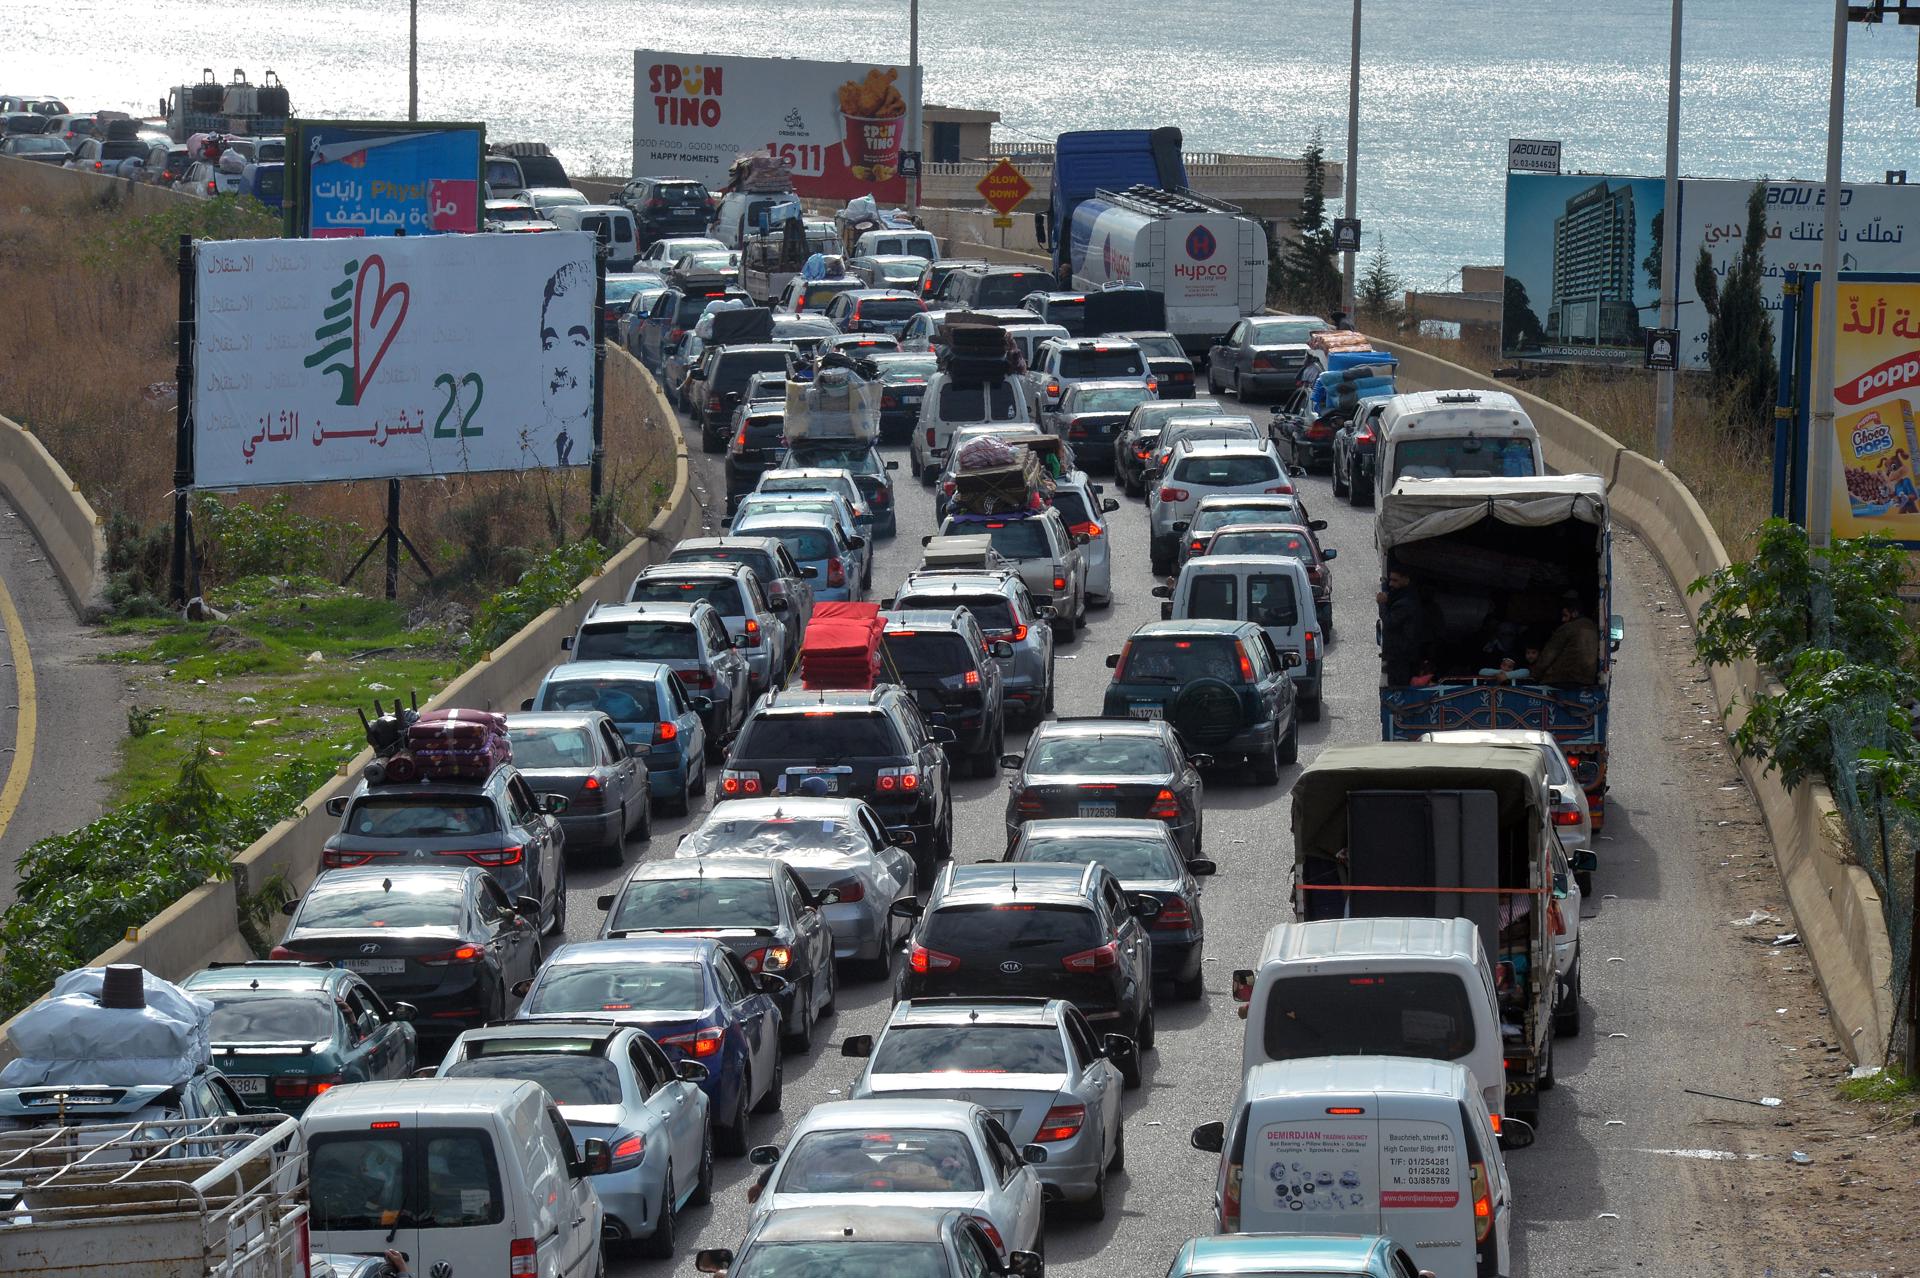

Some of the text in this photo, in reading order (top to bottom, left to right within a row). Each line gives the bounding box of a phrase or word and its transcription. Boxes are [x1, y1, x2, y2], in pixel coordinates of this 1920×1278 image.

[655, 96, 721, 128] TINO
[659, 140, 682, 149] FOOD
[688, 142, 713, 151] GOOD
[866, 137, 894, 150] TINO
[1512, 143, 1541, 156] ABOU
[650, 152, 719, 164] HAPPY MOMENTS
[990, 175, 1019, 184] SLOW
[989, 190, 1019, 198] DOWN
[1762, 187, 1853, 206] BOU ED
[207, 255, 254, 273] الاستقلال
[1174, 263, 1228, 281] Hypco
[433, 372, 484, 439] 22
[242, 409, 299, 465] الثاني
[1852, 426, 1888, 446] Choco
[1855, 435, 1893, 457] POPS
[1003, 963, 1019, 971] KIA
[1267, 1131, 1321, 1140] DEMIRDJIAN
[1383, 1145, 1398, 1154] High
[1390, 1158, 1449, 1166] T/F: 01/254281
[1408, 1167, 1450, 1175] 01/254282
